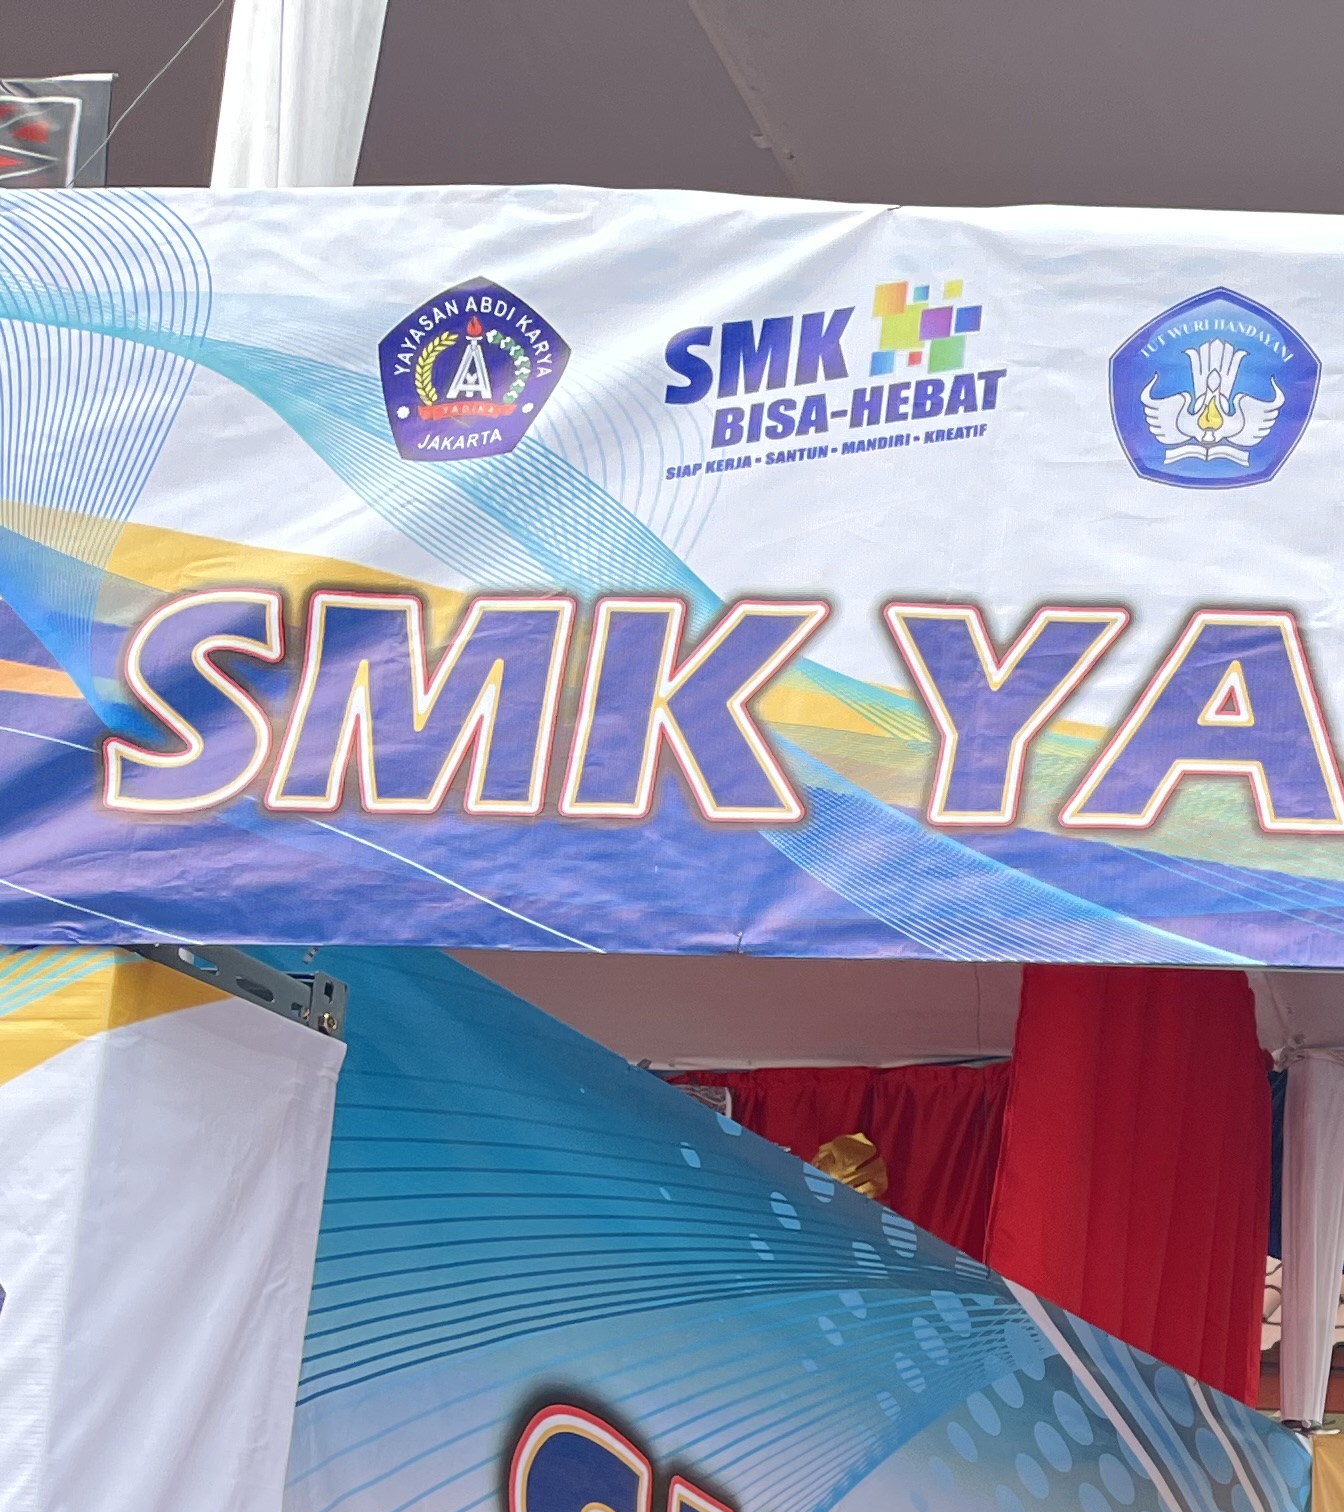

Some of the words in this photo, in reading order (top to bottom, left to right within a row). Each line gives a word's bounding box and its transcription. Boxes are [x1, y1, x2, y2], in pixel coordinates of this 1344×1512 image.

[394, 299, 459, 376] YAYASAN
[465, 296, 516, 321] ABDI
[516, 314, 552, 378] KARYA
[665, 306, 856, 405] SMK
[1139, 334, 1166, 358] TUT
[1168, 319, 1210, 340] WURI
[1214, 318, 1295, 363] HANDAYANI
[417, 428, 502, 451] JAKARTA
[711, 369, 1007, 449] BISA-HEBAT
[665, 464, 701, 481] SIAP
[705, 456, 752, 475] KERJA
[765, 445, 828, 466] SANTUN
[842, 434, 910, 456] MANDIRI
[923, 423, 988, 445] KREATIF
[104, 587, 829, 824] SMK
